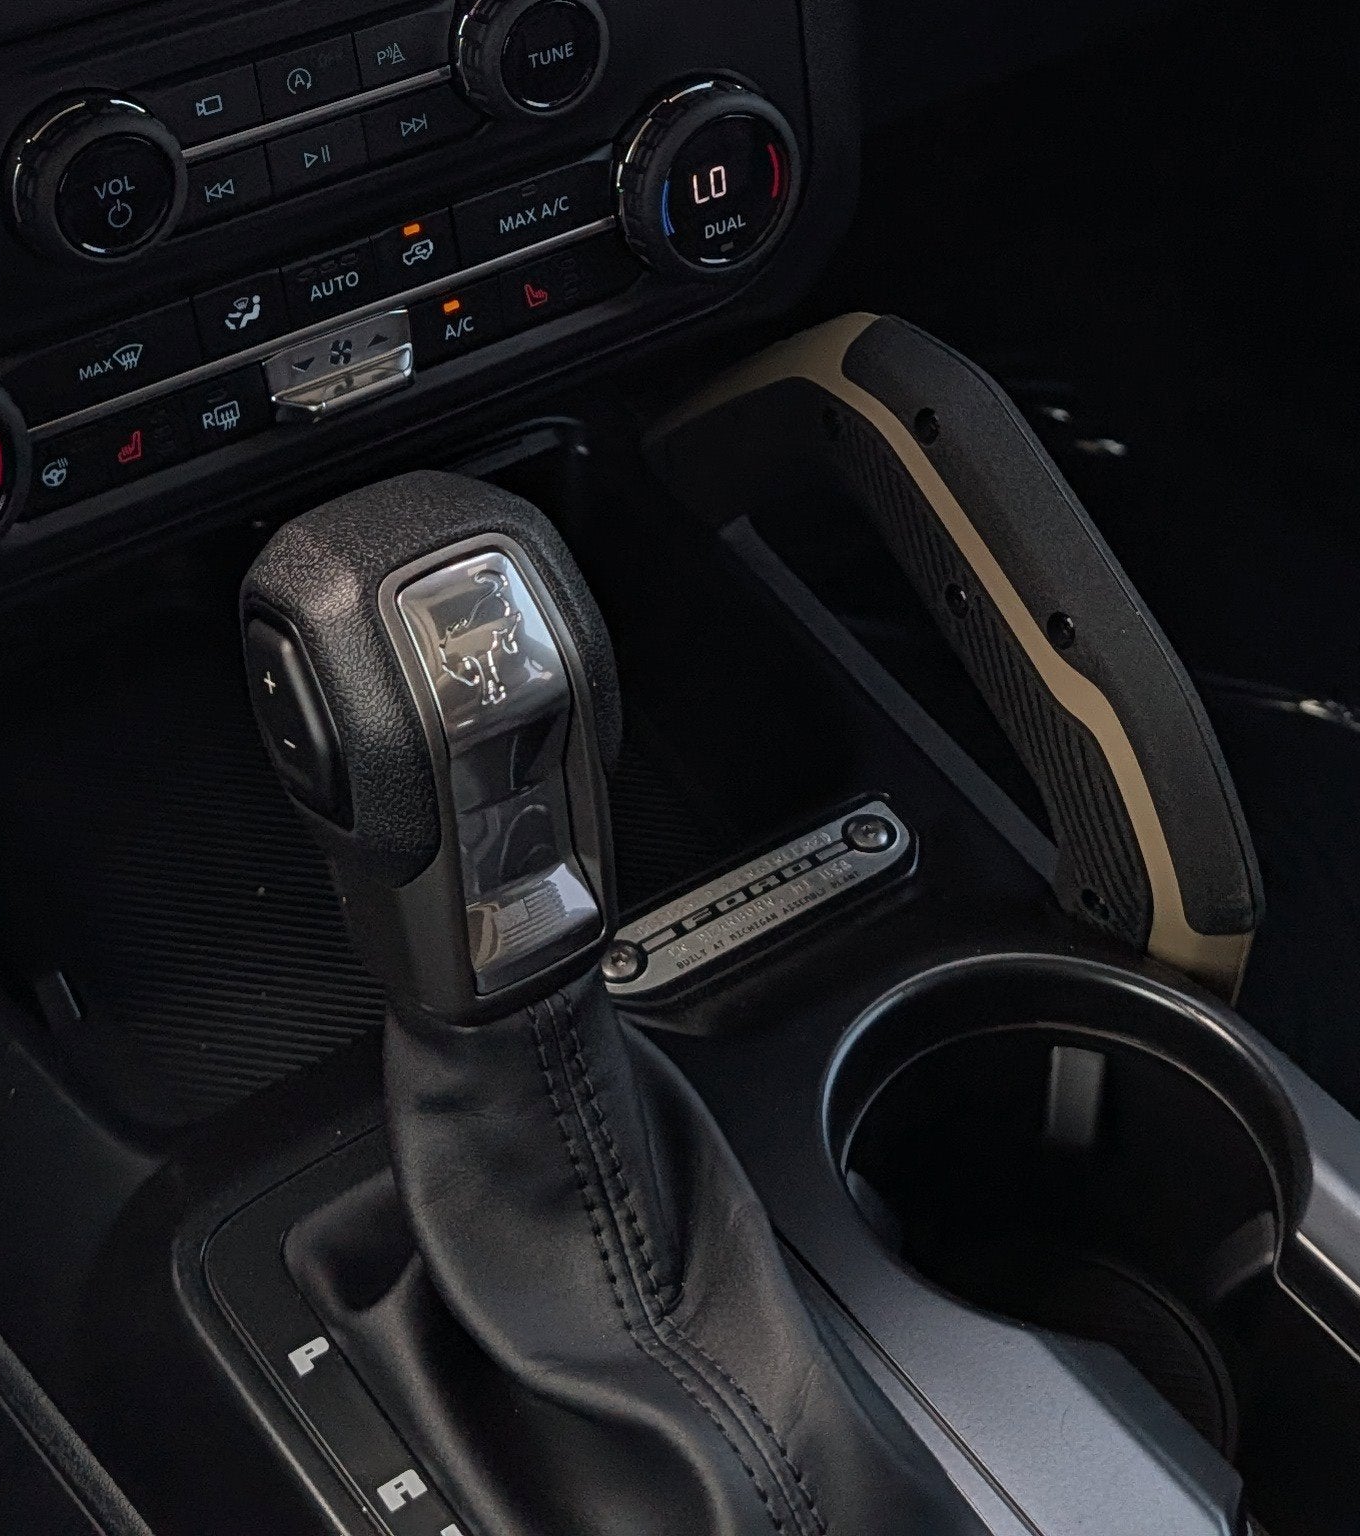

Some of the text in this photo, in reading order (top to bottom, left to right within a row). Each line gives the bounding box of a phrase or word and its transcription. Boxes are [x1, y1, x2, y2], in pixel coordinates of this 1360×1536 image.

[528, 41, 575, 68] TUNE
[93, 177, 135, 200] VOL
[692, 166, 728, 204] LO
[498, 196, 570, 234] MAX A/C
[704, 214, 747, 239] DUAL
[310, 271, 359, 302] AUTO
[444, 316, 475, 341] A/C
[79, 358, 114, 380] MAX
[681, 858, 813, 931] FORD
[713, 939, 726, 951] AT
[728, 912, 779, 941] MICHIGAN
[288, 1336, 330, 1377] P
[377, 1469, 427, 1512] R
